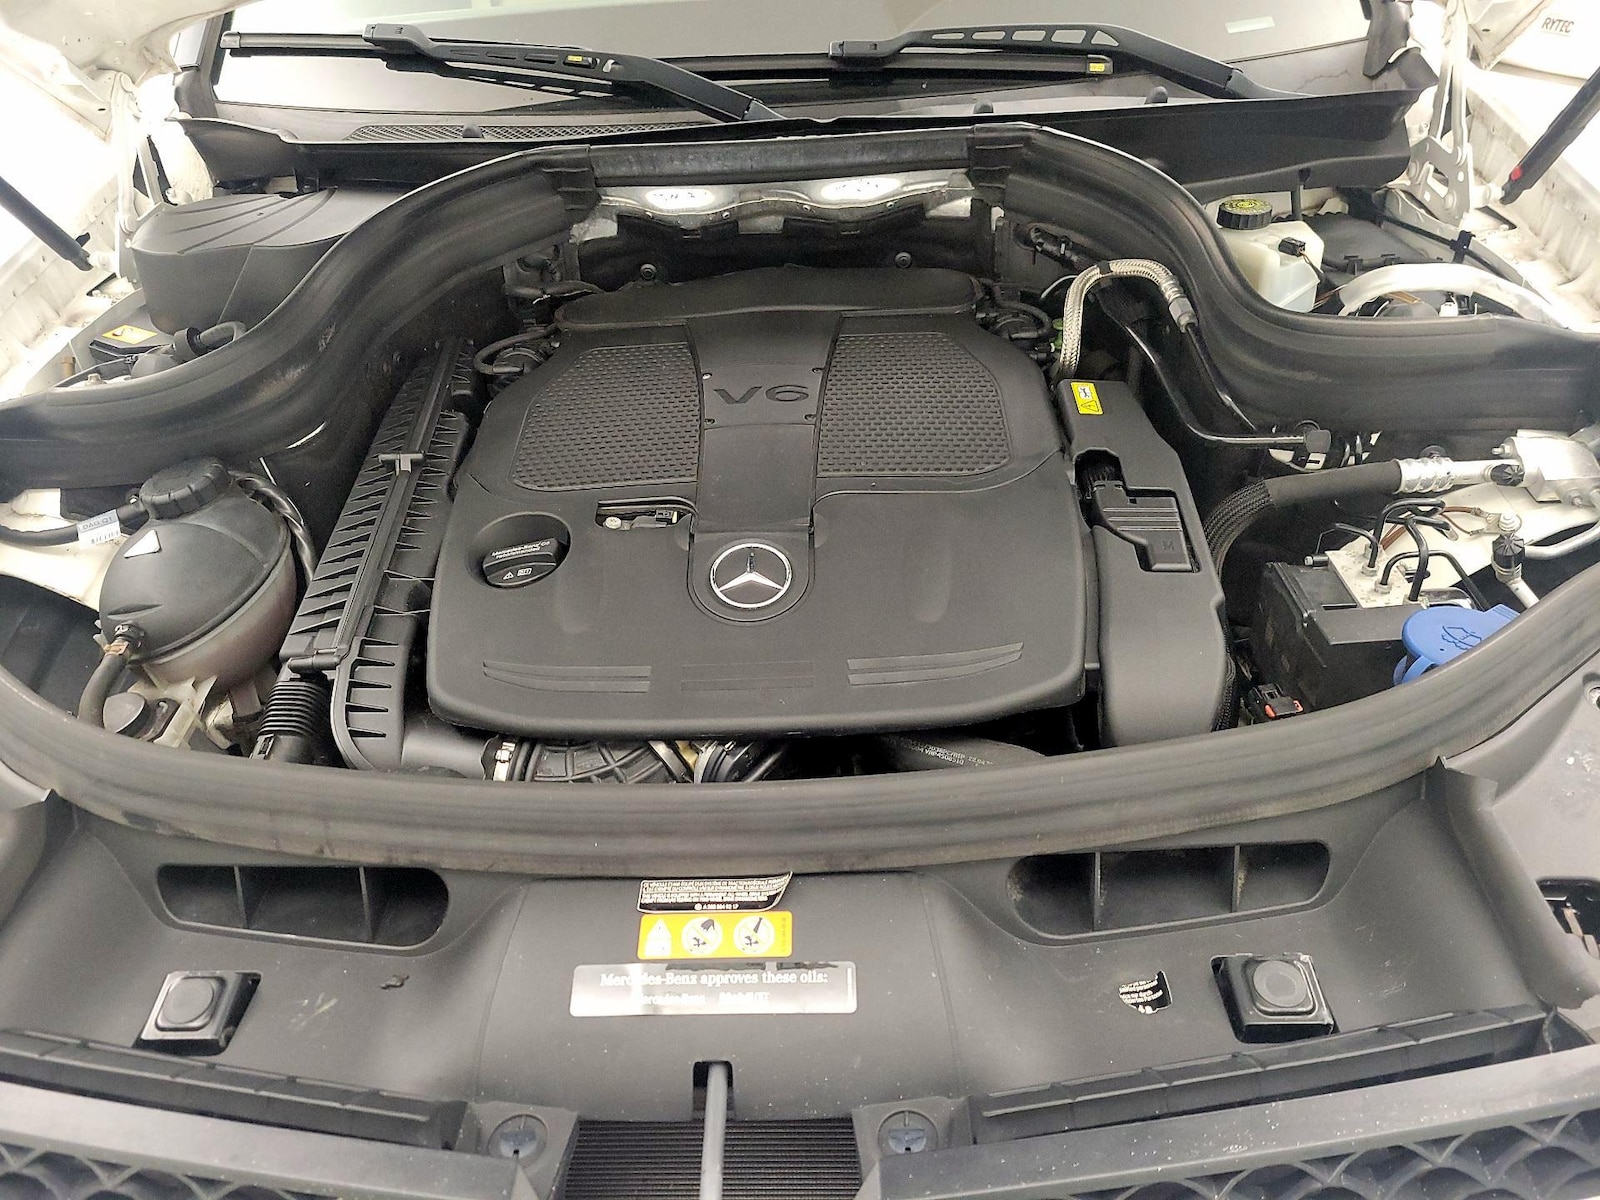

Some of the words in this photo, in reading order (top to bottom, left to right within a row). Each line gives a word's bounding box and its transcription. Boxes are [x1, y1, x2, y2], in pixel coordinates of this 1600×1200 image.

[1541, 17, 1574, 33] RYTEC
[713, 384, 809, 404] V6
[600, 972, 698, 986] Mercdes-Benz
[701, 973, 759, 988] approves
[762, 971, 798, 984] these
[800, 970, 829, 984] oils:
